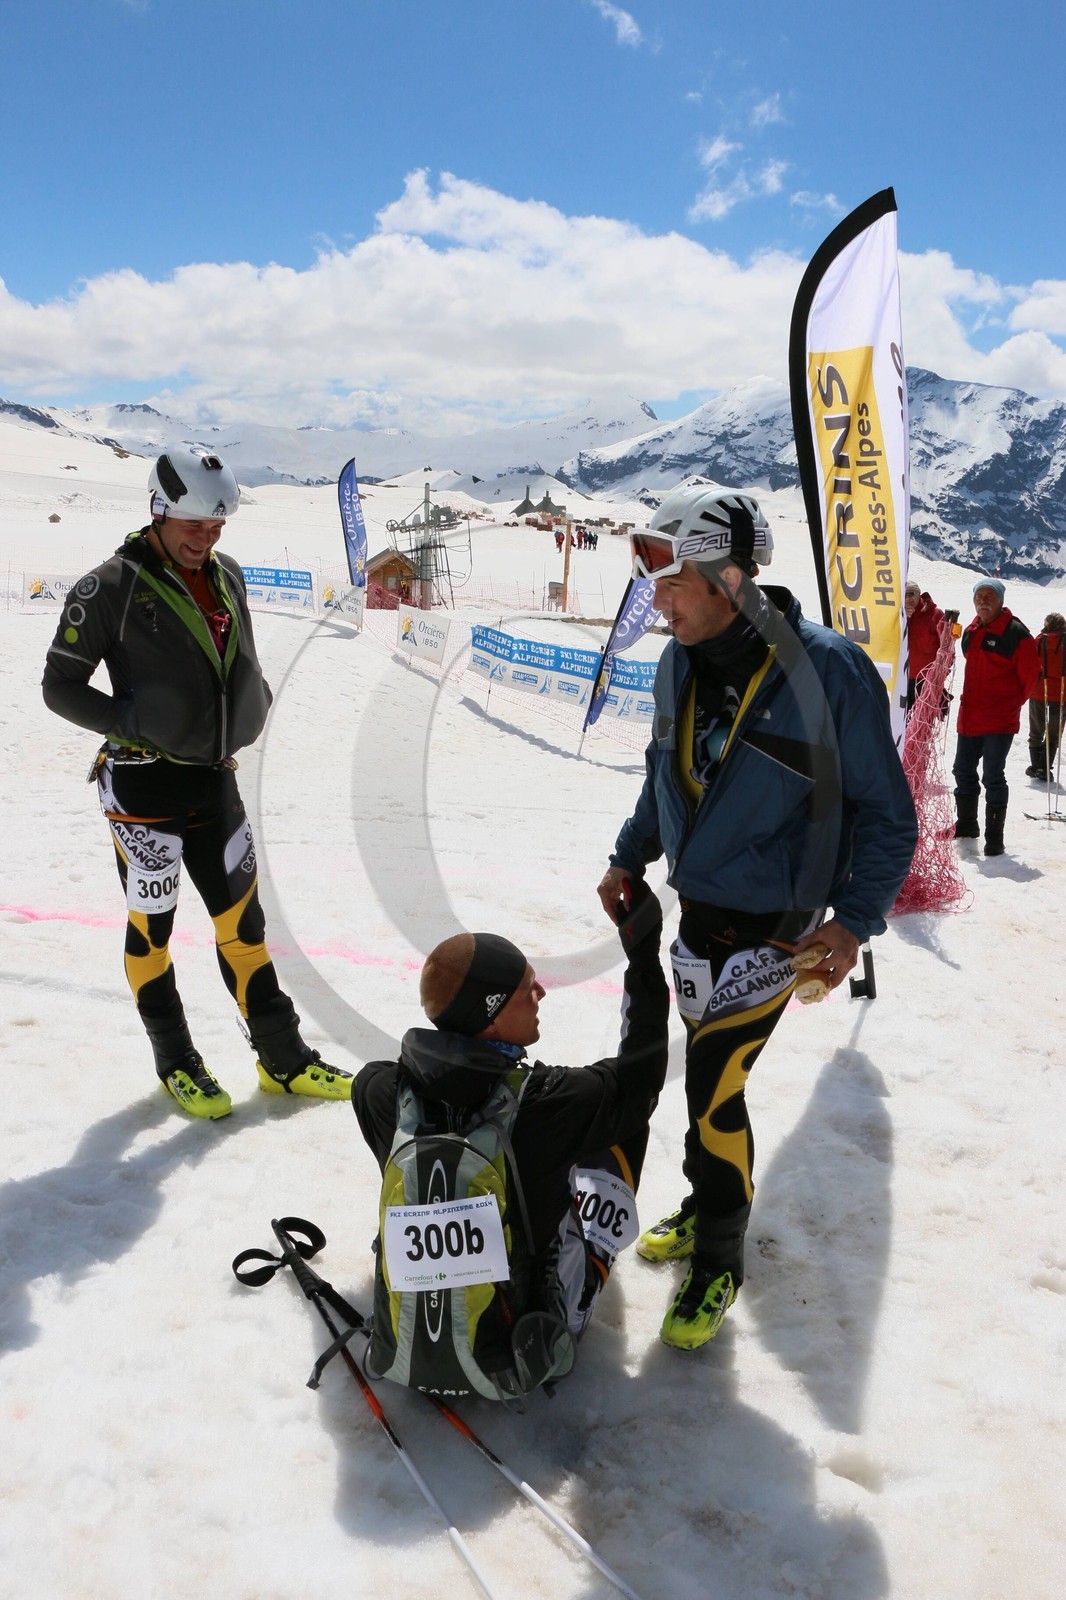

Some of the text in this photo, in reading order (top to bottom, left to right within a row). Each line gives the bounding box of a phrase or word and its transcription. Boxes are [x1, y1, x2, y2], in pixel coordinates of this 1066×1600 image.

[817, 362, 871, 645] ÉCRINS
[855, 402, 895, 606] Hautes-Alpes
[280, 579, 311, 587] ALPINISME
[418, 620, 446, 640] Orcières
[422, 637, 438, 649] 1850
[512, 643, 528, 651] SKI
[560, 650, 572, 660] SKI
[134, 830, 170, 858] C.A.F.
[731, 952, 775, 978] C.A.F.
[404, 1219, 485, 1261] 300b
[417, 1386, 469, 1396] CAMP
